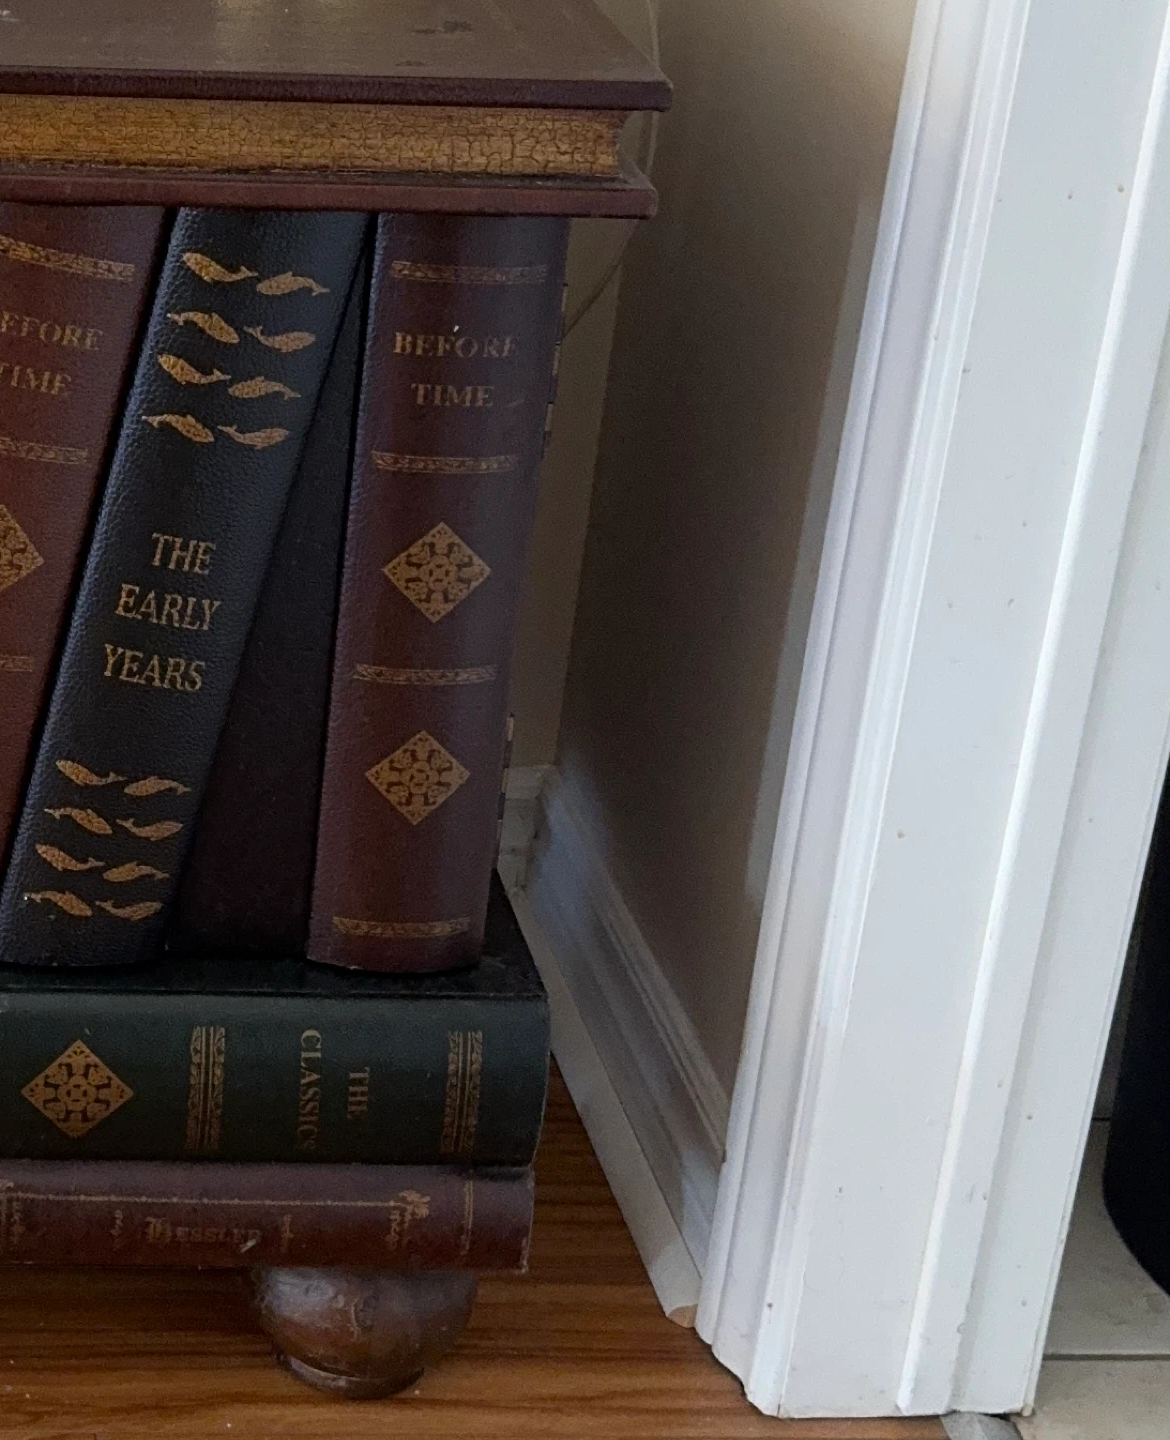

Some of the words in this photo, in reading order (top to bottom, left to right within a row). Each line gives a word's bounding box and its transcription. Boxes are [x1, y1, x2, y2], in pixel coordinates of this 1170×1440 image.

[394, 332, 516, 358] BEFORE
[412, 383, 495, 408] TIME
[151, 532, 217, 576] THE
[115, 584, 221, 631] EARLY
[103, 644, 206, 692] YEARS
[346, 1066, 371, 1120] THE
